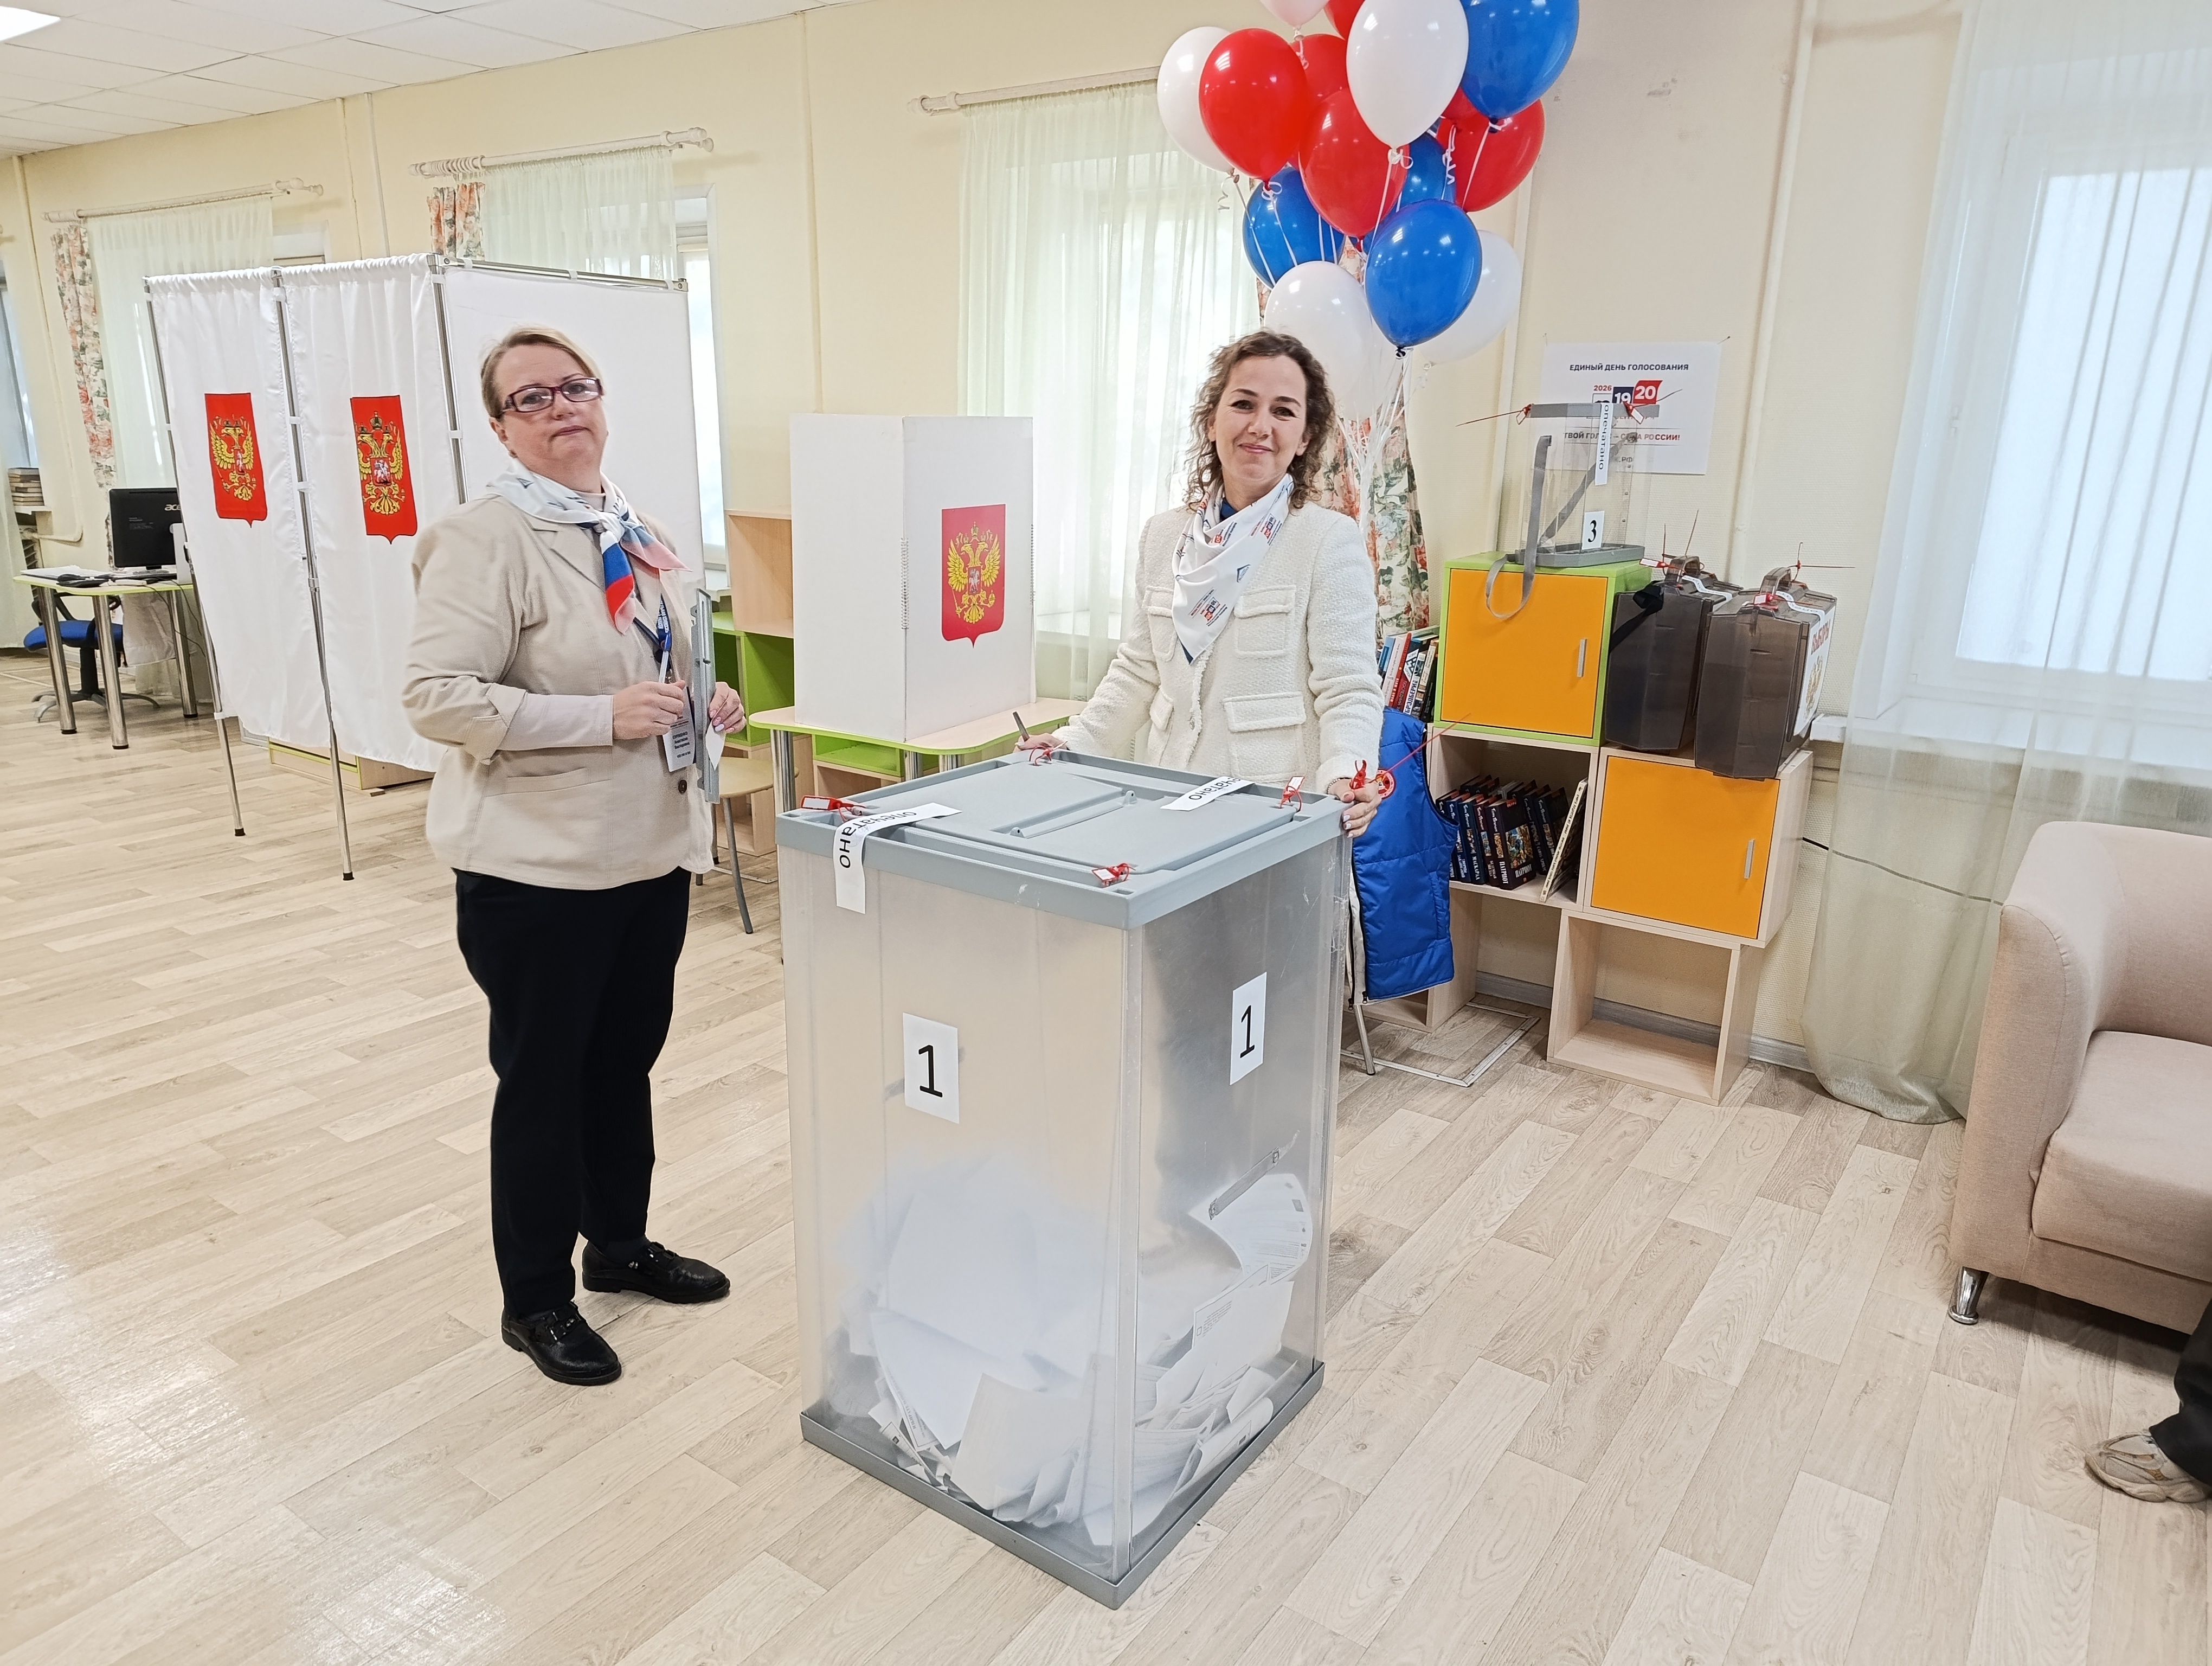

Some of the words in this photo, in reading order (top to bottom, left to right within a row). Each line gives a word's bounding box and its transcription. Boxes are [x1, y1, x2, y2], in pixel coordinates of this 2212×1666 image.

[1570, 363, 1603, 371] ЕДИНЫЙ
[1614, 392, 1631, 403] 19
[1635, 386, 1656, 400] 20
[1598, 405, 1609, 470] опечатано
[1587, 520, 1597, 542] 3
[839, 811, 917, 868] опечатано
[1472, 856, 1480, 880] МАСКАРАД
[1499, 861, 1509, 884] ПАТРИОТ
[1515, 863, 1532, 878] ПАТРИОТ
[1240, 1004, 1255, 1058] 1
[918, 1045, 943, 1098] 1
